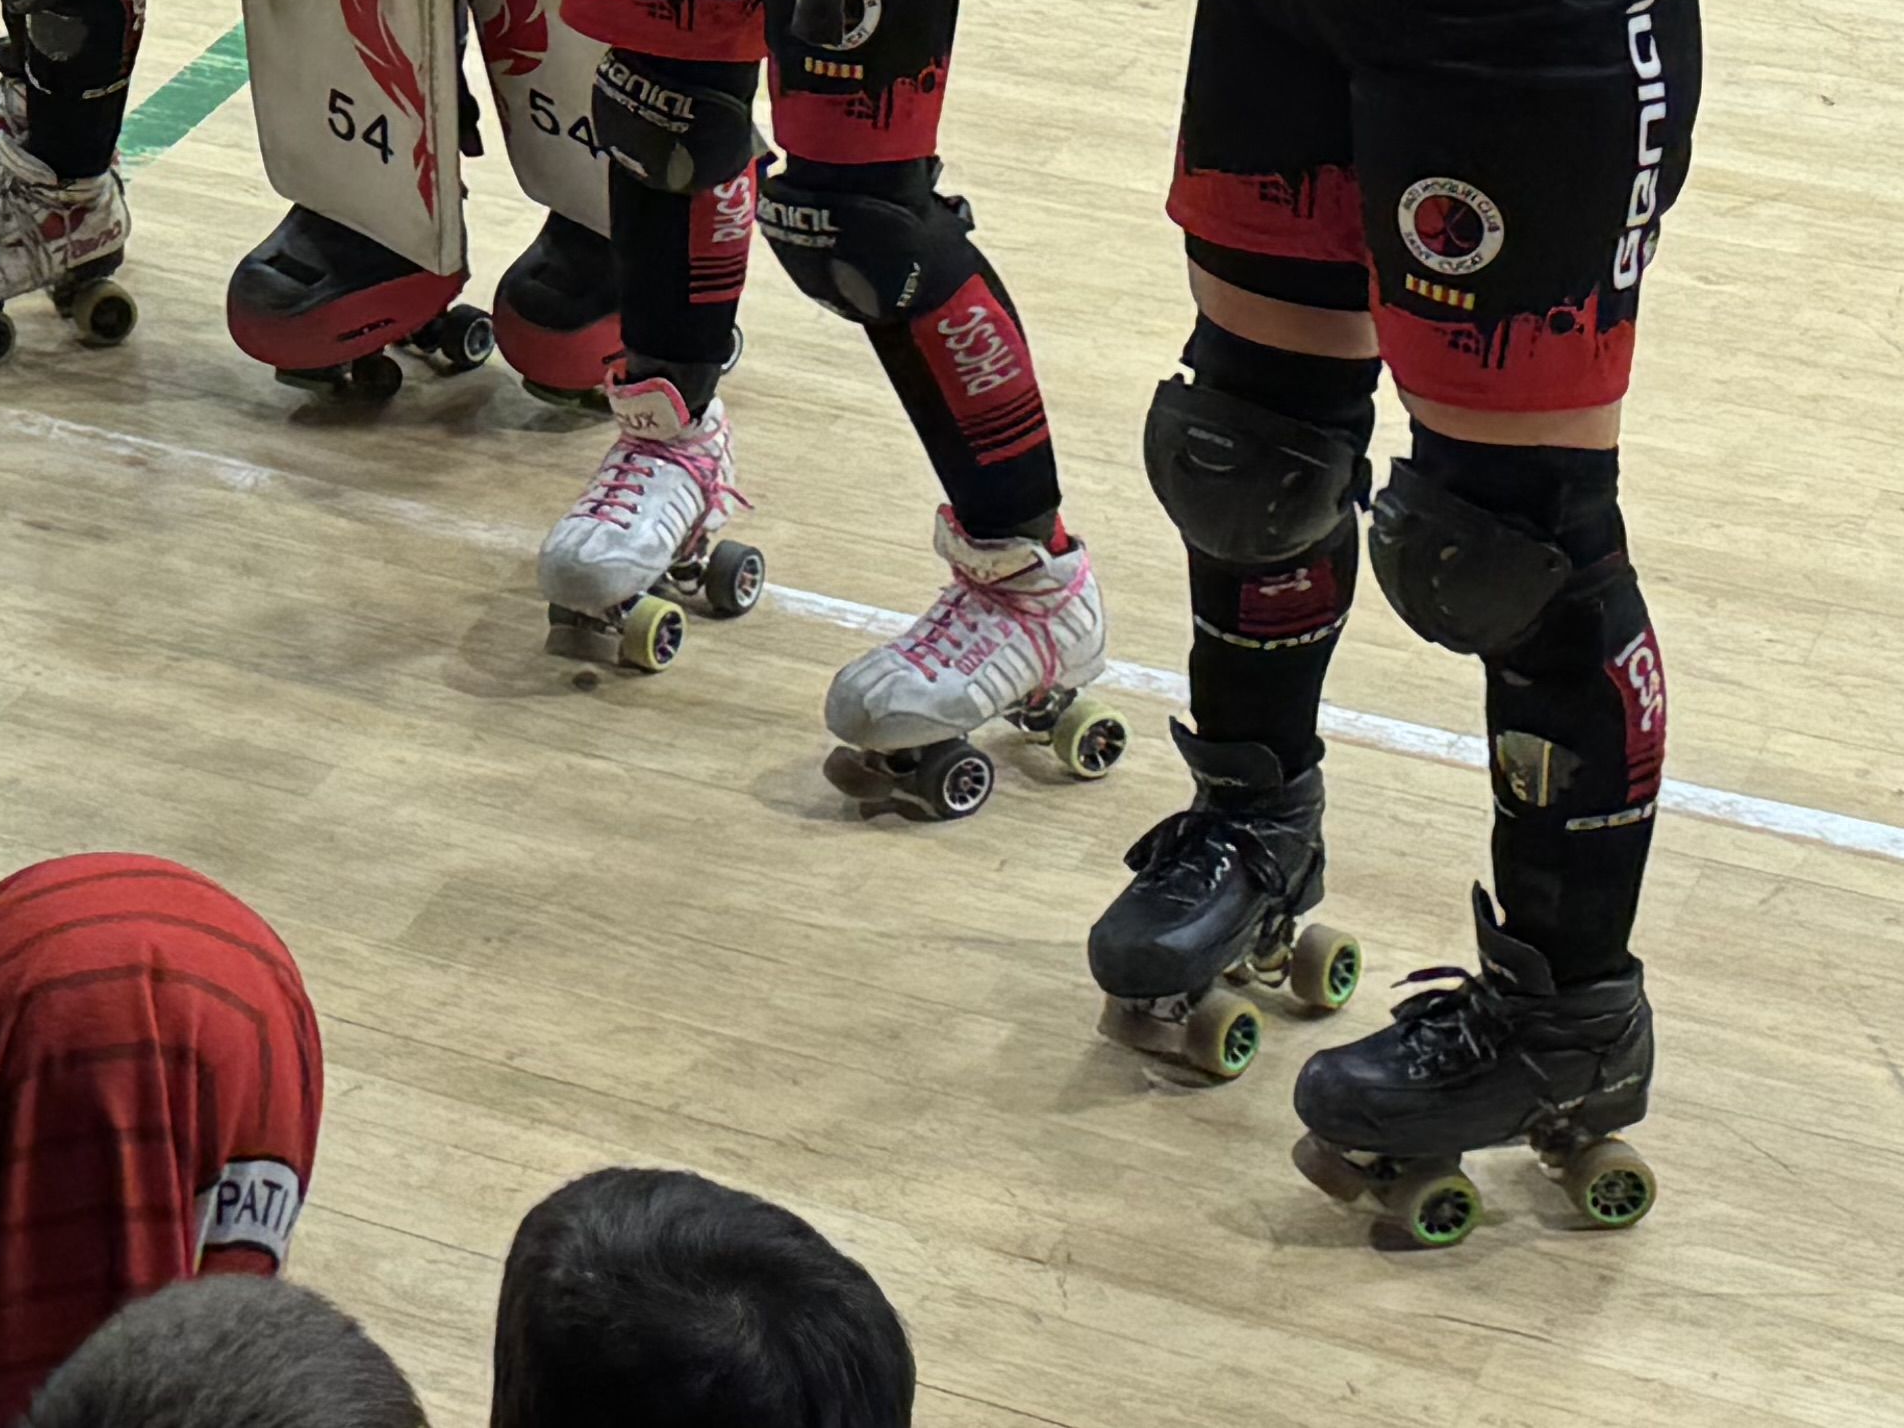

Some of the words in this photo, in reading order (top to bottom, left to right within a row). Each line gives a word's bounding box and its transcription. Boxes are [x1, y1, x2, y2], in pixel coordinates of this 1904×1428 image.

[327, 87, 396, 165] 54
[528, 92, 607, 162] 54
[216, 1178, 294, 1239] PATI
